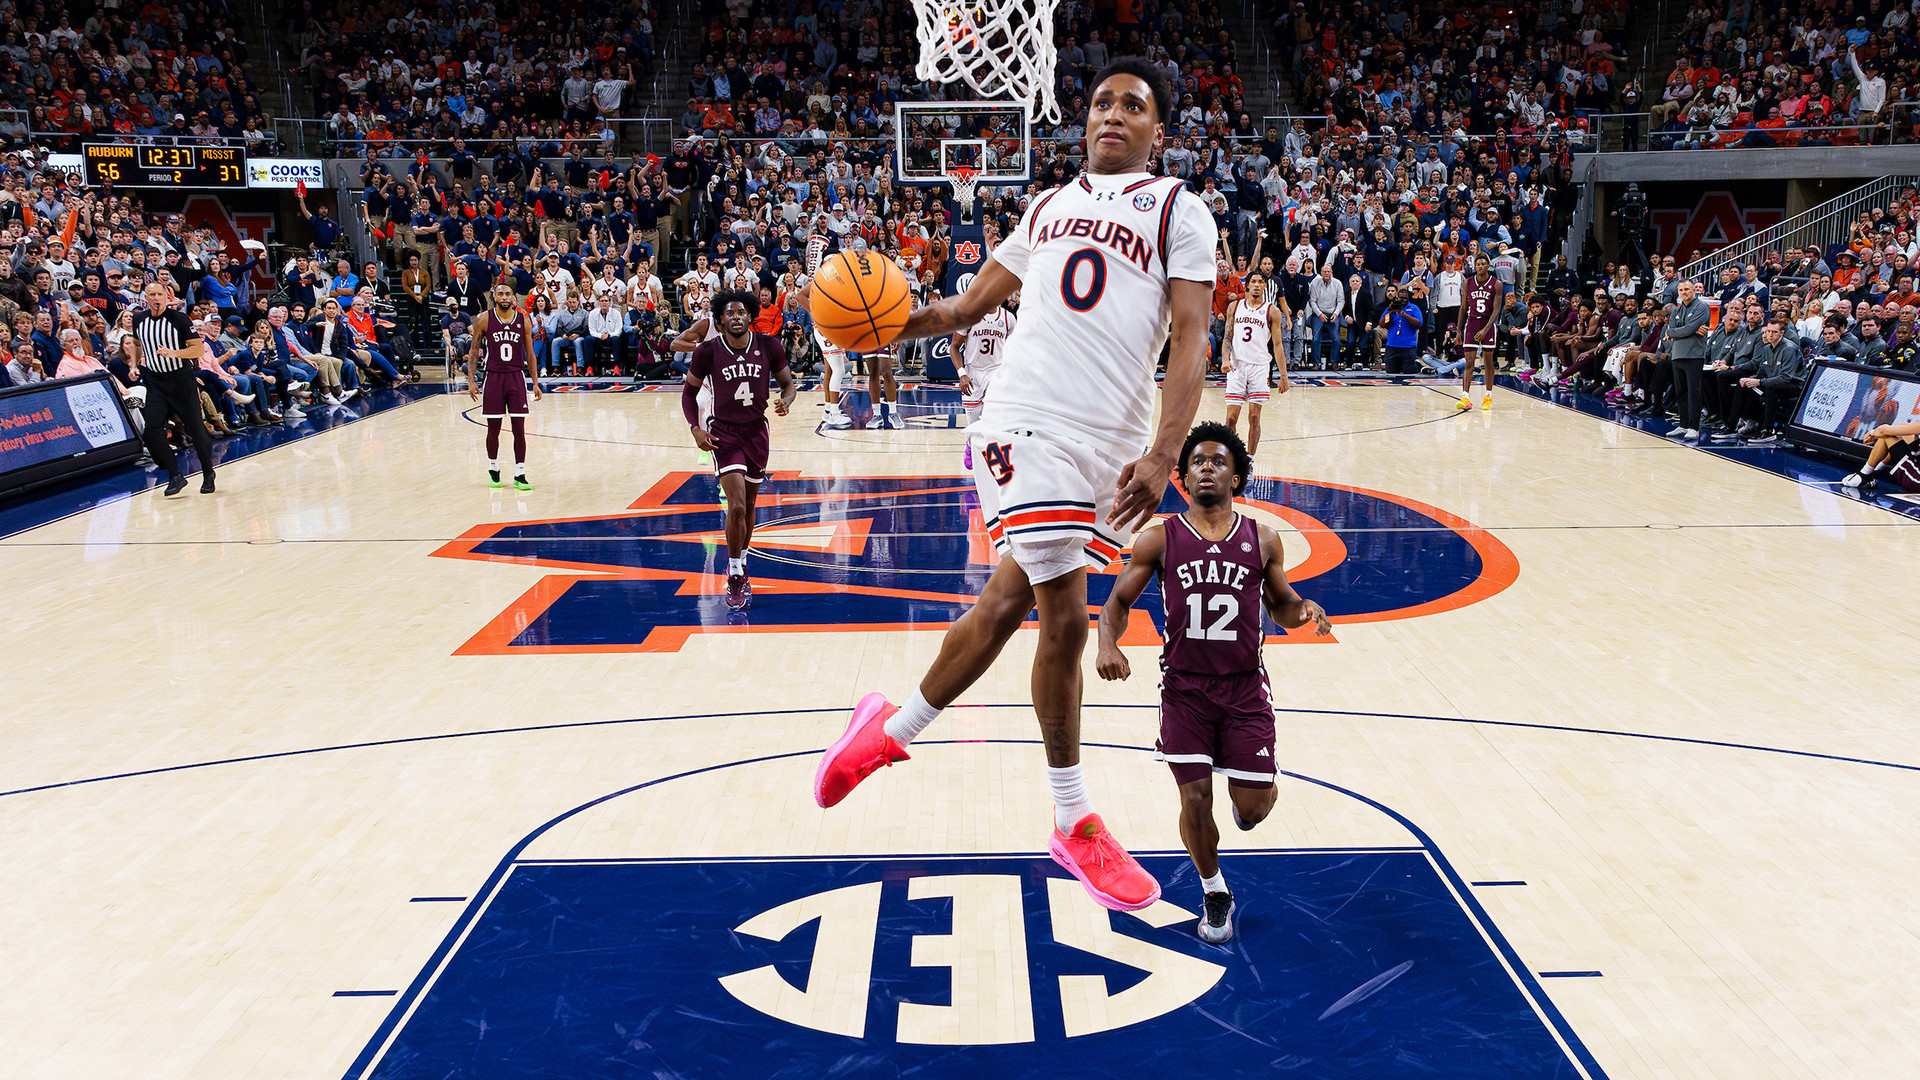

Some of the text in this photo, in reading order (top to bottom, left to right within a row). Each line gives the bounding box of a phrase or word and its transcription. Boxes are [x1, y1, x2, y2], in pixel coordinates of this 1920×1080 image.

[88, 146, 134, 158] AUBURN
[148, 148, 191, 166] 12:37
[97, 163, 120, 180] 56
[149, 170, 182, 183] PERIOD 2
[220, 165, 240, 182] 37
[270, 165, 321, 176] COOK'S
[1033, 218, 1153, 274] AUBURN
[57, 278, 69, 291] 10
[1060, 247, 1107, 313] 0
[1412, 289, 1424, 299] 34
[1470, 290, 1491, 300] STATE
[1476, 299, 1486, 313] 5
[1235, 316, 1265, 329] AUBURN
[492, 330, 521, 343] STATE
[973, 328, 1005, 340] AUBURN
[1242, 326, 1253, 343] 3
[500, 343, 513, 362] 0
[979, 338, 996, 356] 31
[721, 363, 762, 381] STATE
[734, 381, 754, 407] 4
[1812, 391, 1839, 407] PUBLIC
[77, 407, 106, 424] PUBLIC
[1805, 406, 1835, 421] HEALTH
[84, 421, 115, 439] HEALTH
[1176, 559, 1250, 591] STATE
[1185, 593, 1239, 641] 12
[718, 873, 1227, 1046] SEC
